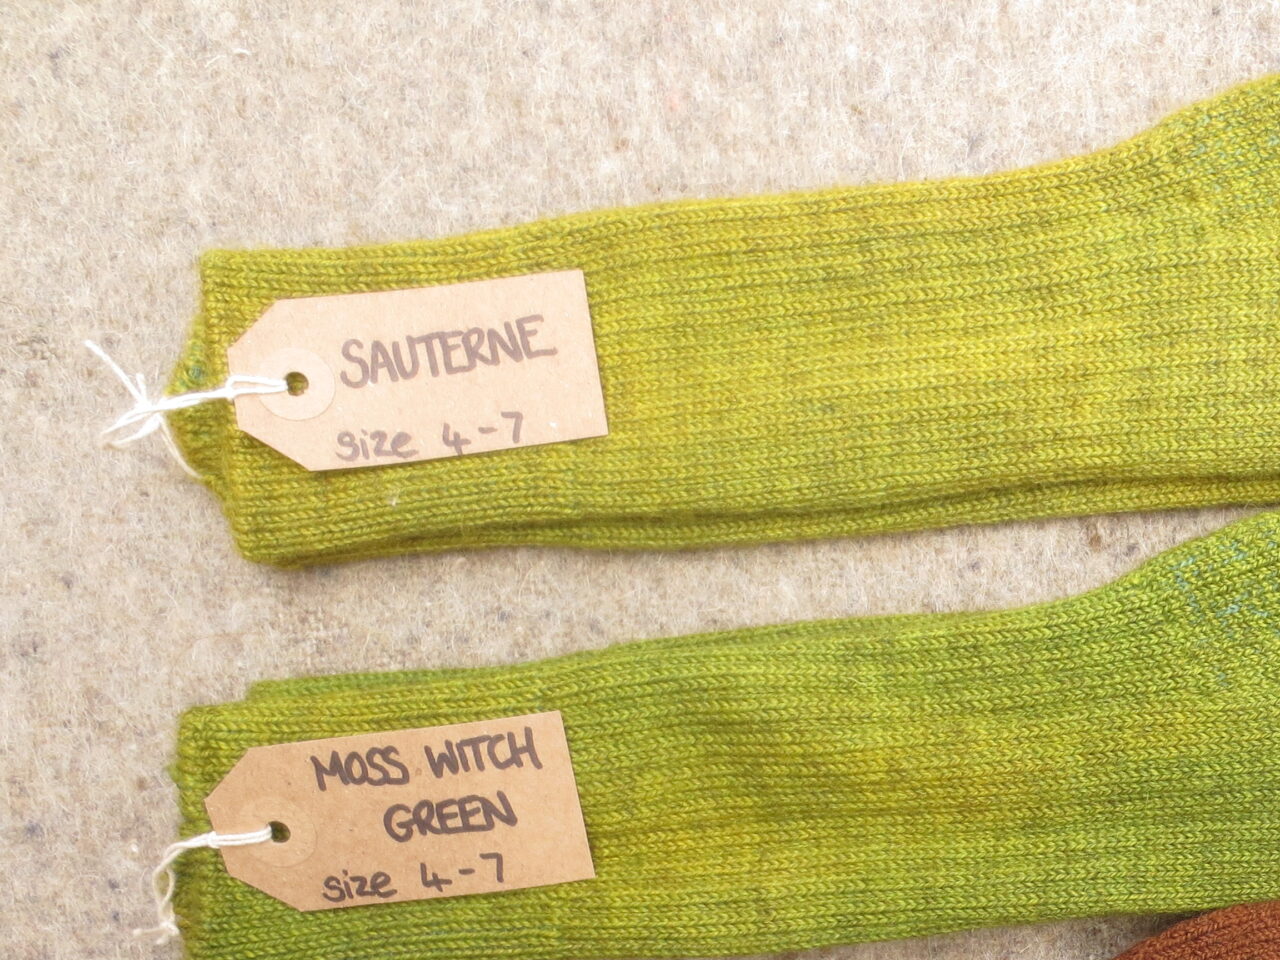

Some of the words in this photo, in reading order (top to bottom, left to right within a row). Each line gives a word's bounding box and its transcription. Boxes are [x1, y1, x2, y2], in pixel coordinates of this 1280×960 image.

[340, 314, 558, 389] SAUTERNE
[310, 745, 410, 791] MOSS
[424, 726, 543, 778] WITCH
[383, 790, 518, 842] GREEN
[322, 869, 398, 901] size
